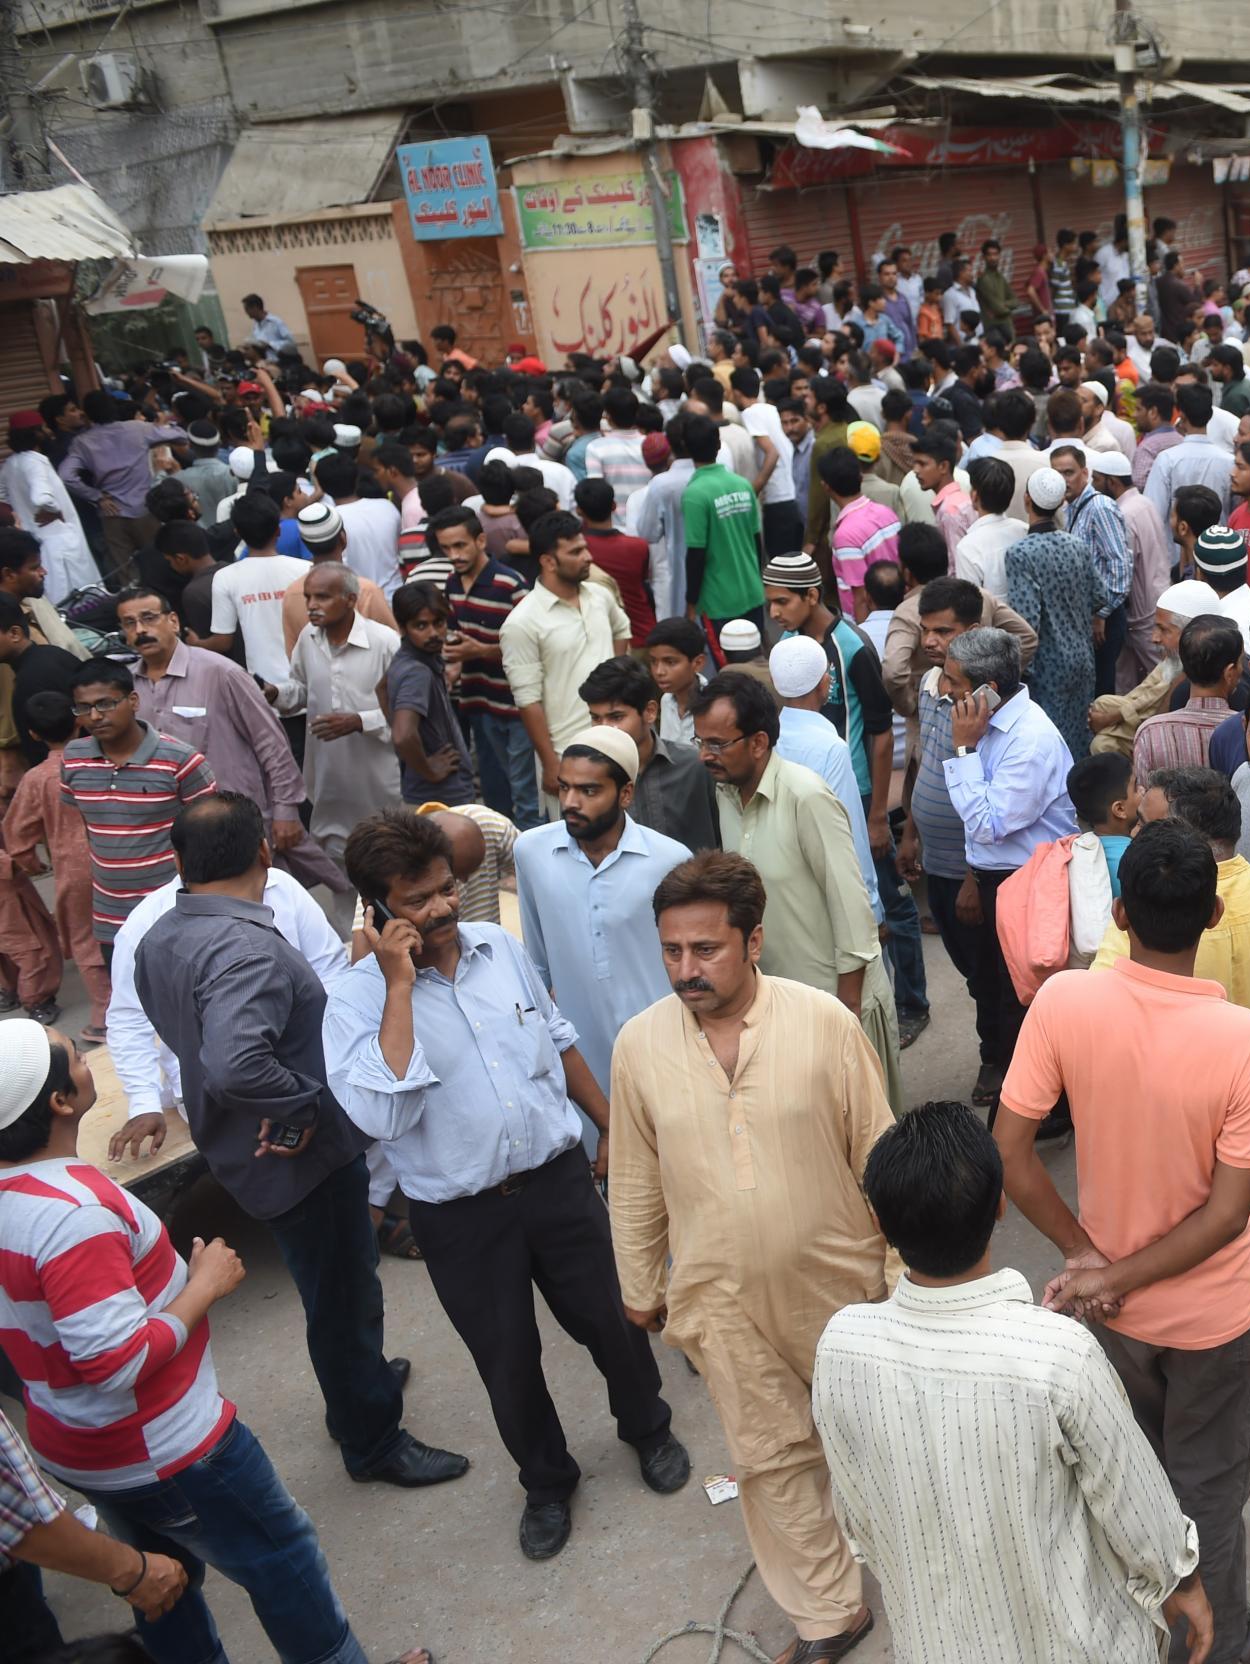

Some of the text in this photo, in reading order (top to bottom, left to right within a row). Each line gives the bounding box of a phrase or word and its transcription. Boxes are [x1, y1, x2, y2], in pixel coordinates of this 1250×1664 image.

[407, 161, 487, 193] AL NOOR CLINIC
[415, 196, 492, 232] النور کلینک
